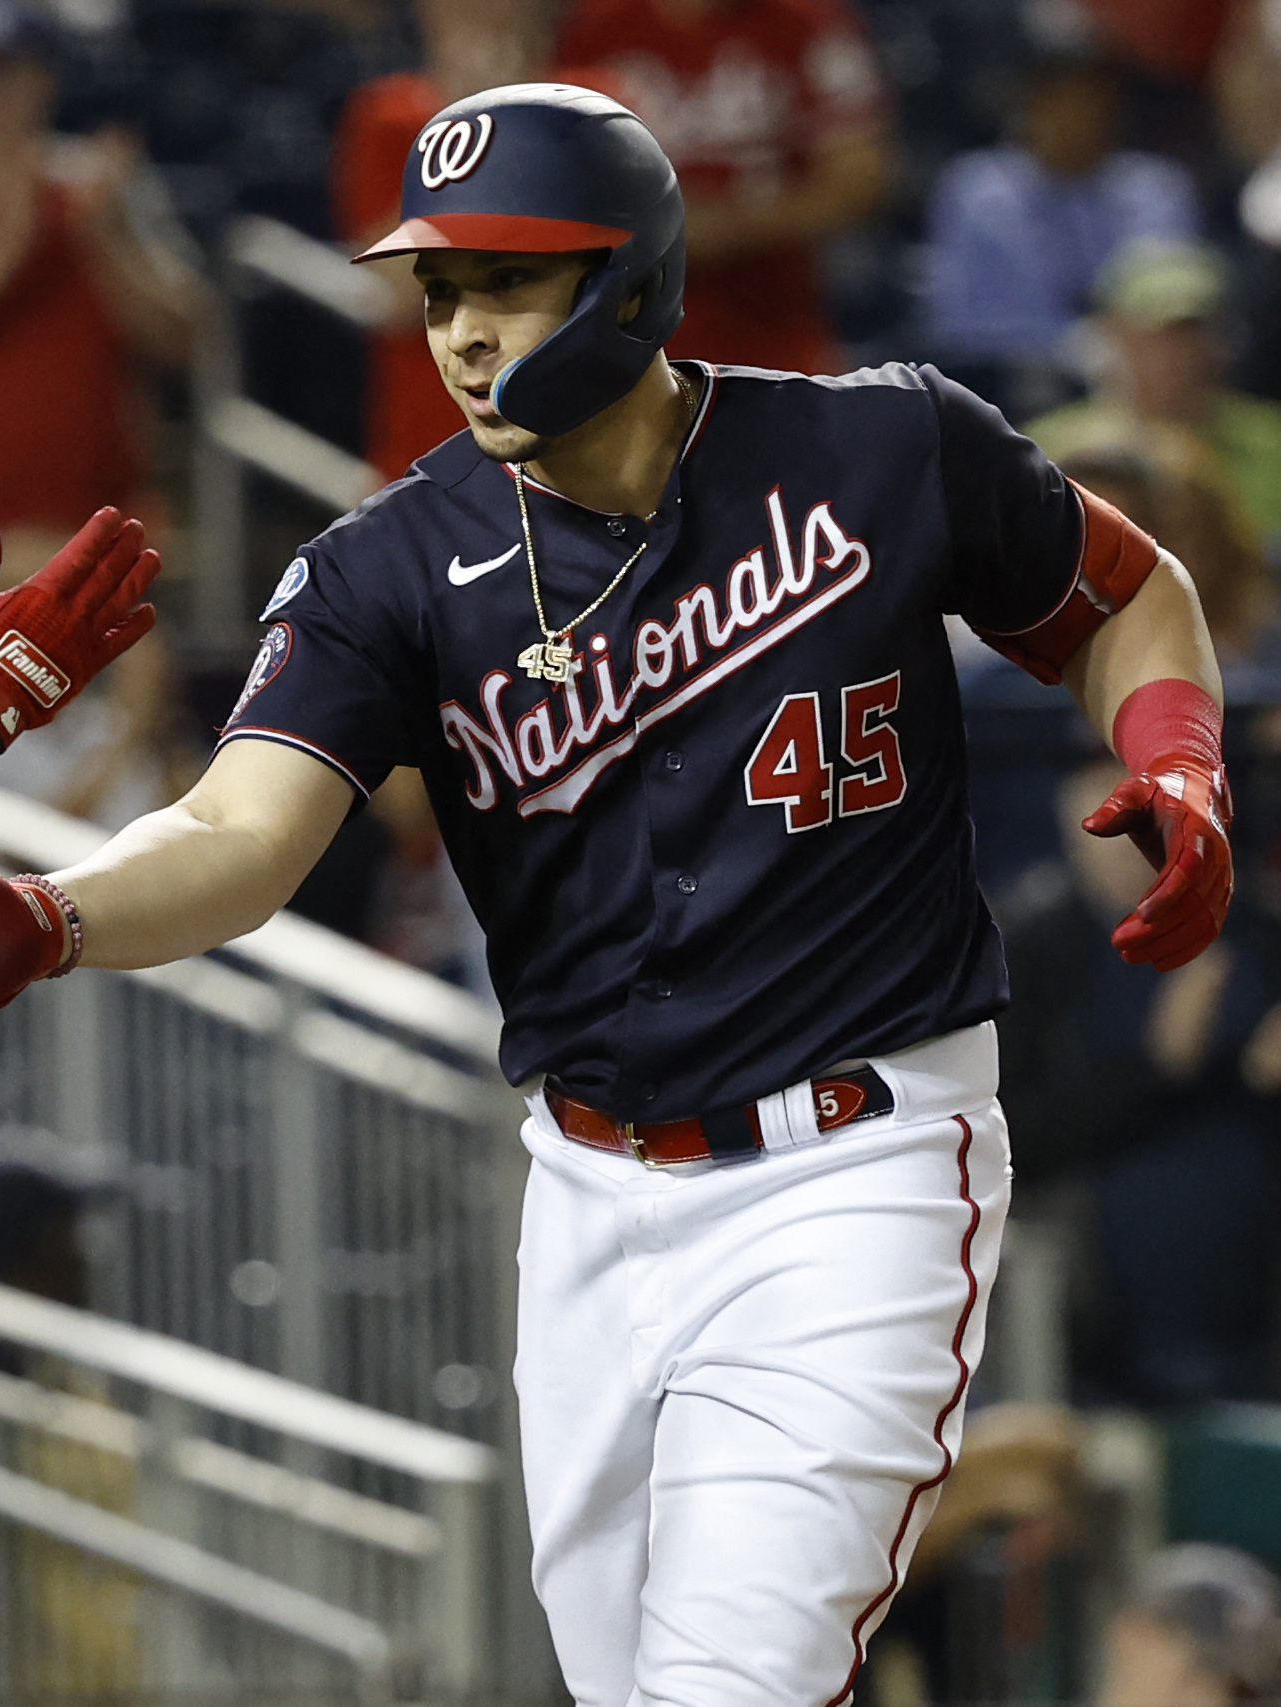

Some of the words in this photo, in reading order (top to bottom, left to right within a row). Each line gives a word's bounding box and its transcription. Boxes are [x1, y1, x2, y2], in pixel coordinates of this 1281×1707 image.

[418, 113, 495, 191] W
[438, 483, 871, 813] Nationals
[517, 643, 573, 682] 45
[744, 670, 907, 834] 45
[815, 1090, 839, 1119] 5
